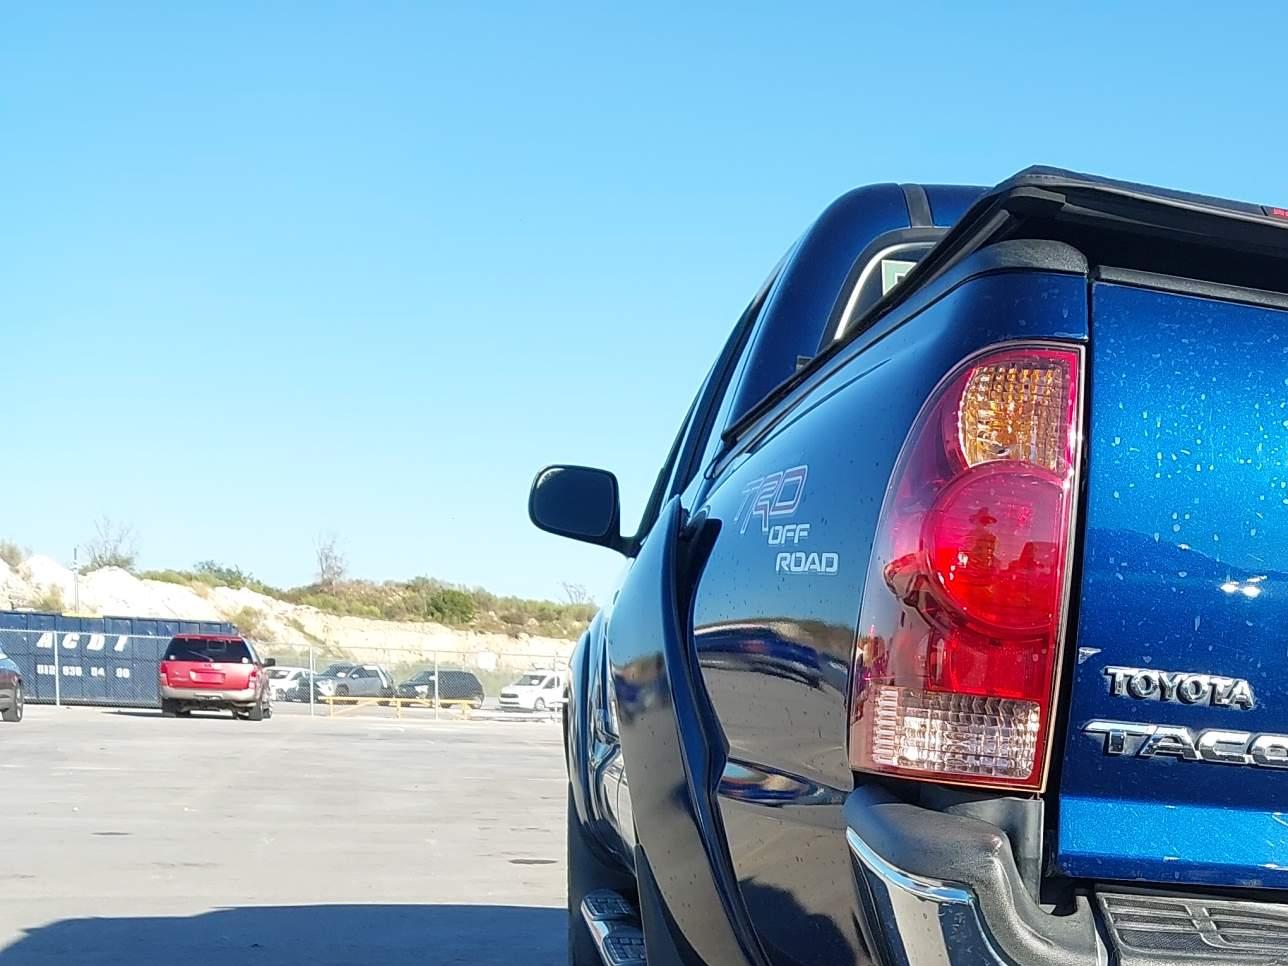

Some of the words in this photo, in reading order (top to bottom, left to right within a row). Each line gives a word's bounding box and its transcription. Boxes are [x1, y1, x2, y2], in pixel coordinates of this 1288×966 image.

[735, 465, 808, 535] TRD
[768, 523, 810, 545] OFF
[776, 552, 839, 574] ROAD
[1103, 667, 1255, 710] TOYOTA
